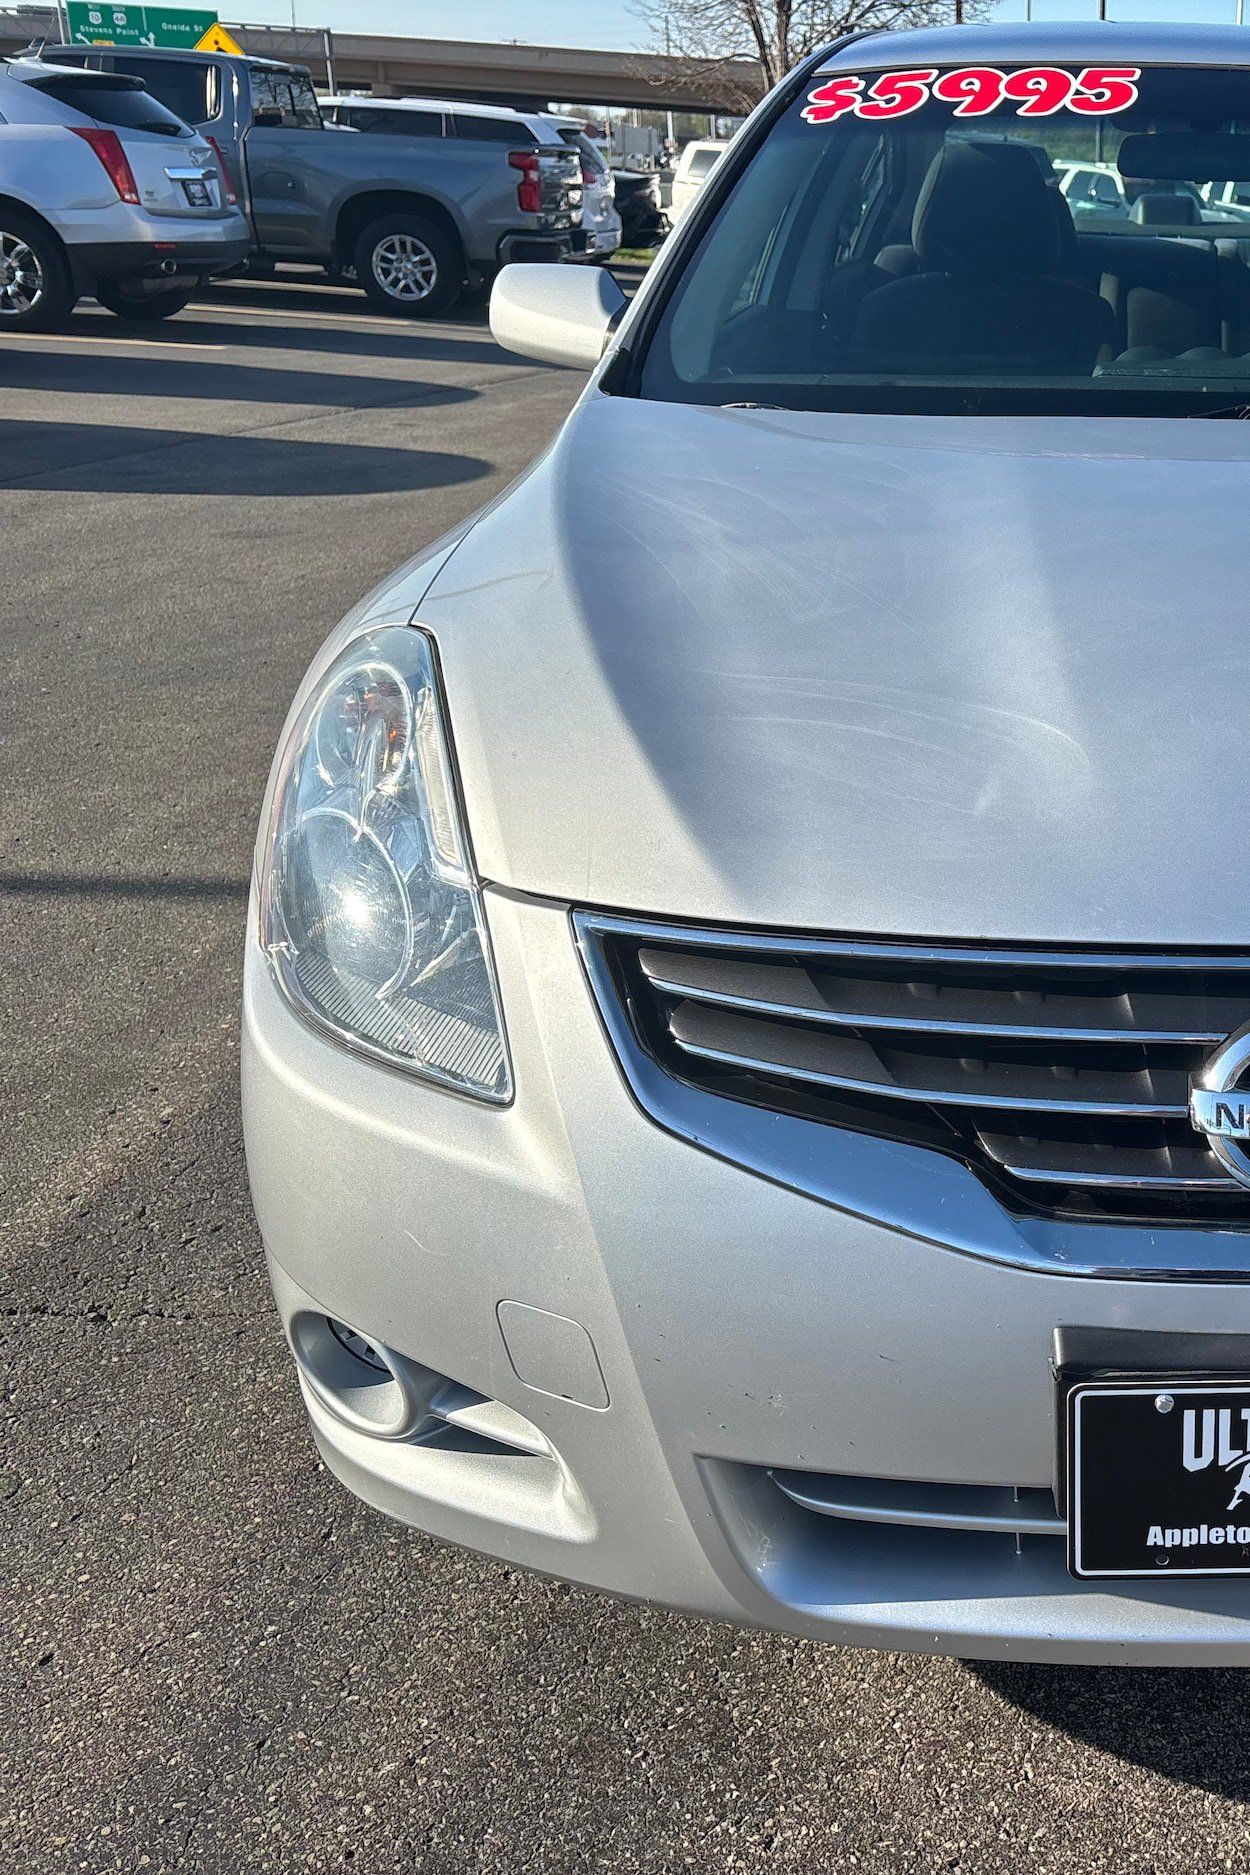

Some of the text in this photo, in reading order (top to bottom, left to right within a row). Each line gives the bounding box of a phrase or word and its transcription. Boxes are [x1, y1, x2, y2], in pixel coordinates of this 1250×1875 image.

[80, 25, 139, 36] Stevens Point
[193, 24, 203, 33] St
[800, 66, 1143, 125] $5995
